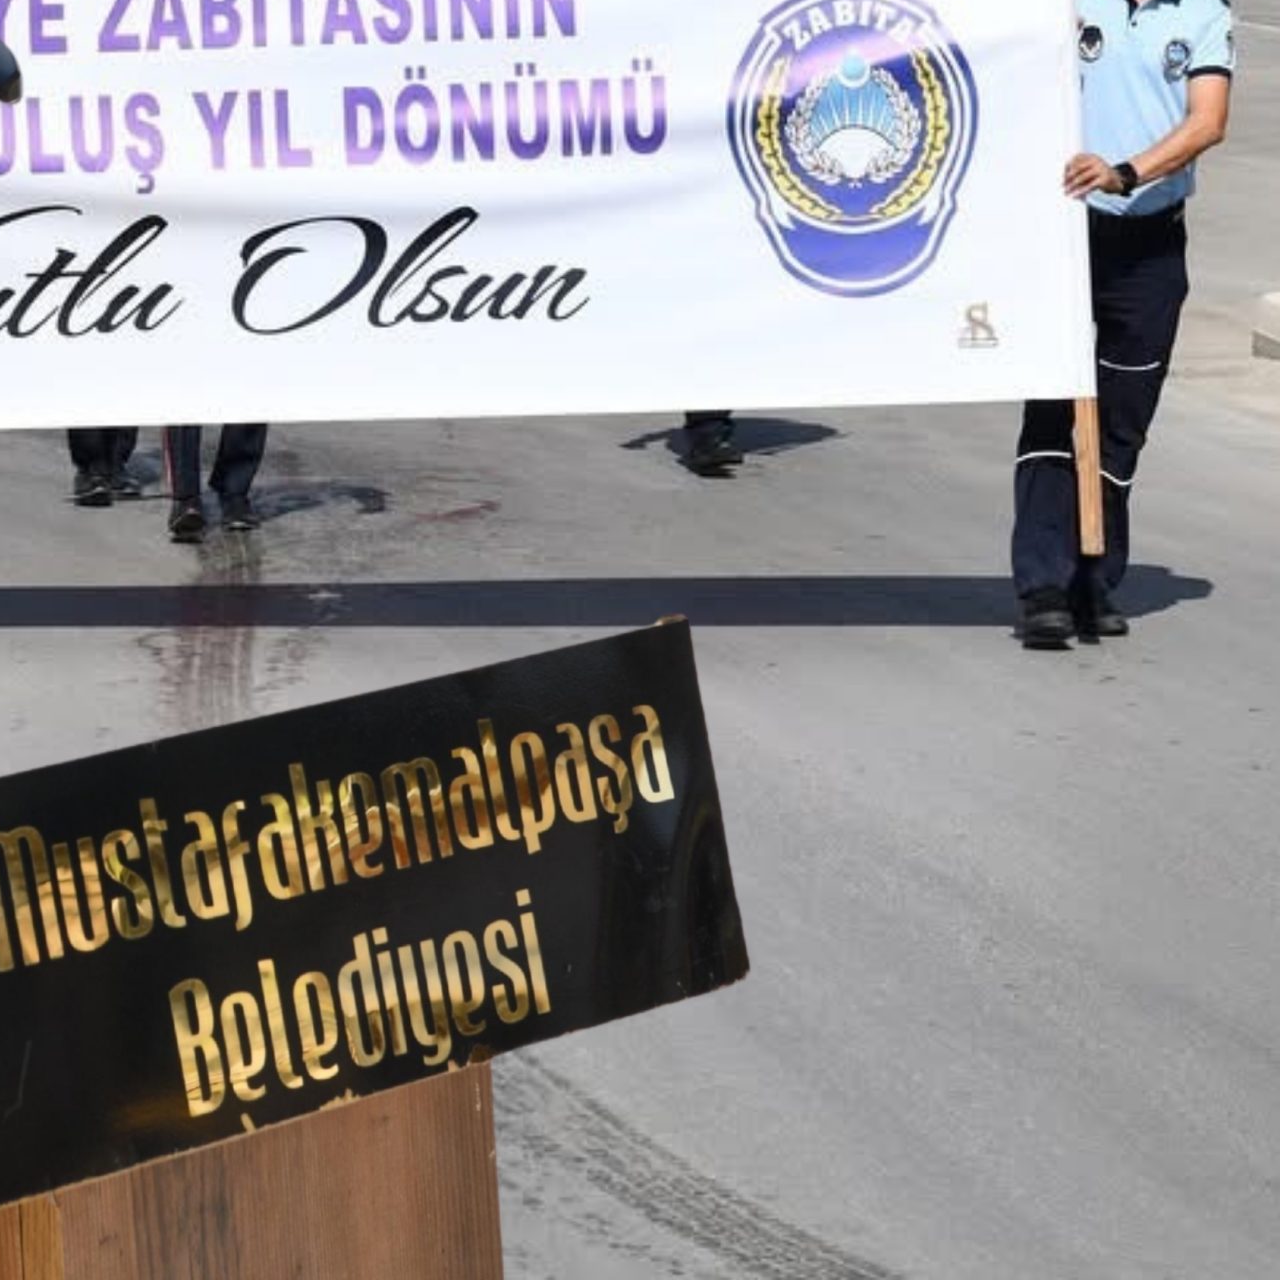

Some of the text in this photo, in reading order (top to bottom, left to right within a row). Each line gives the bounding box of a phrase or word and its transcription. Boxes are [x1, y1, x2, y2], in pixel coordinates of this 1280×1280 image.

[192, 87, 314, 170] YIL
[342, 57, 669, 167] DÖNÜMÜ
[231, 205, 590, 337] Olsun
[168, 888, 553, 1118] Belediyesi
